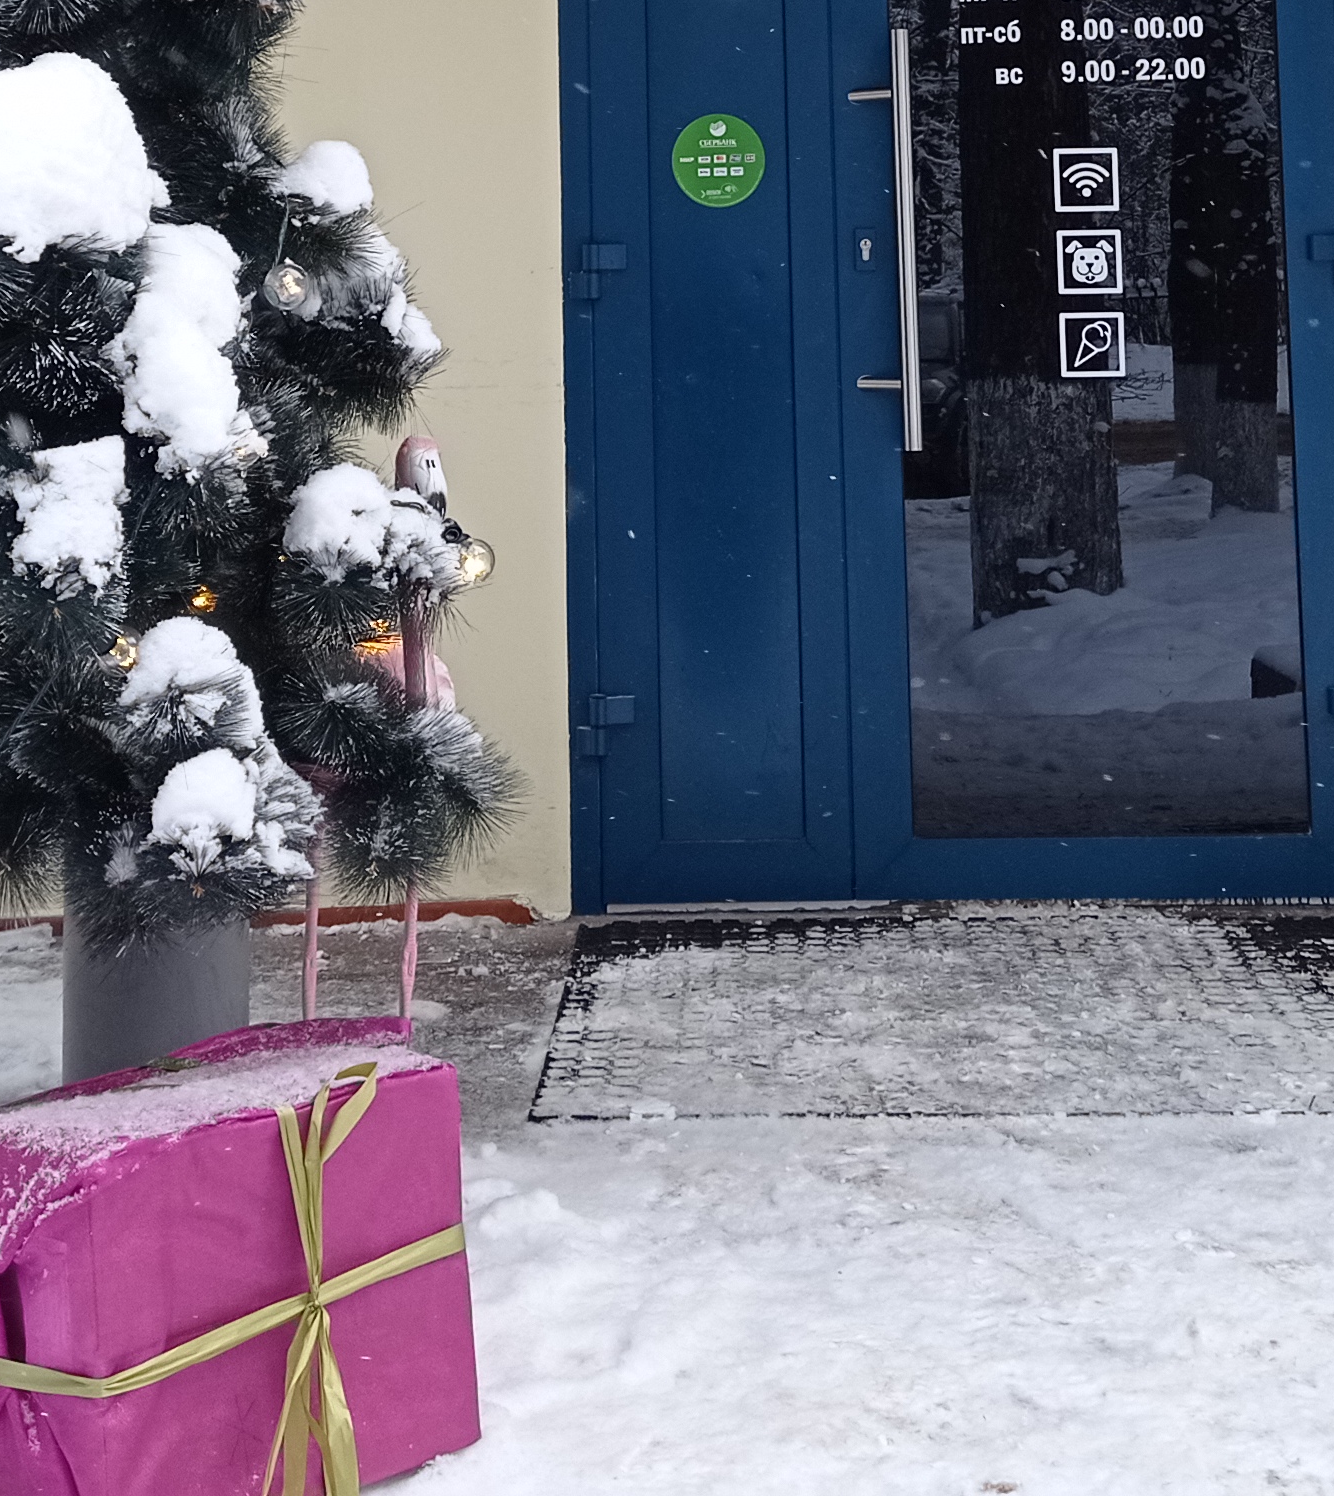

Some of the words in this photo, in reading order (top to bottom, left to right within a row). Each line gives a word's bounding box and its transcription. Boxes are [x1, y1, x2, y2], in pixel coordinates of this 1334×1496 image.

[960, 20, 1021, 44] пт-сб
[1060, 18, 1114, 41] 8.00
[1134, 16, 1204, 39] 00.00
[995, 65, 1024, 85] вс
[1061, 60, 1115, 83] 9.00
[1135, 57, 1206, 80] 22.00
[698, 139, 737, 147] СБЕРБАНК
